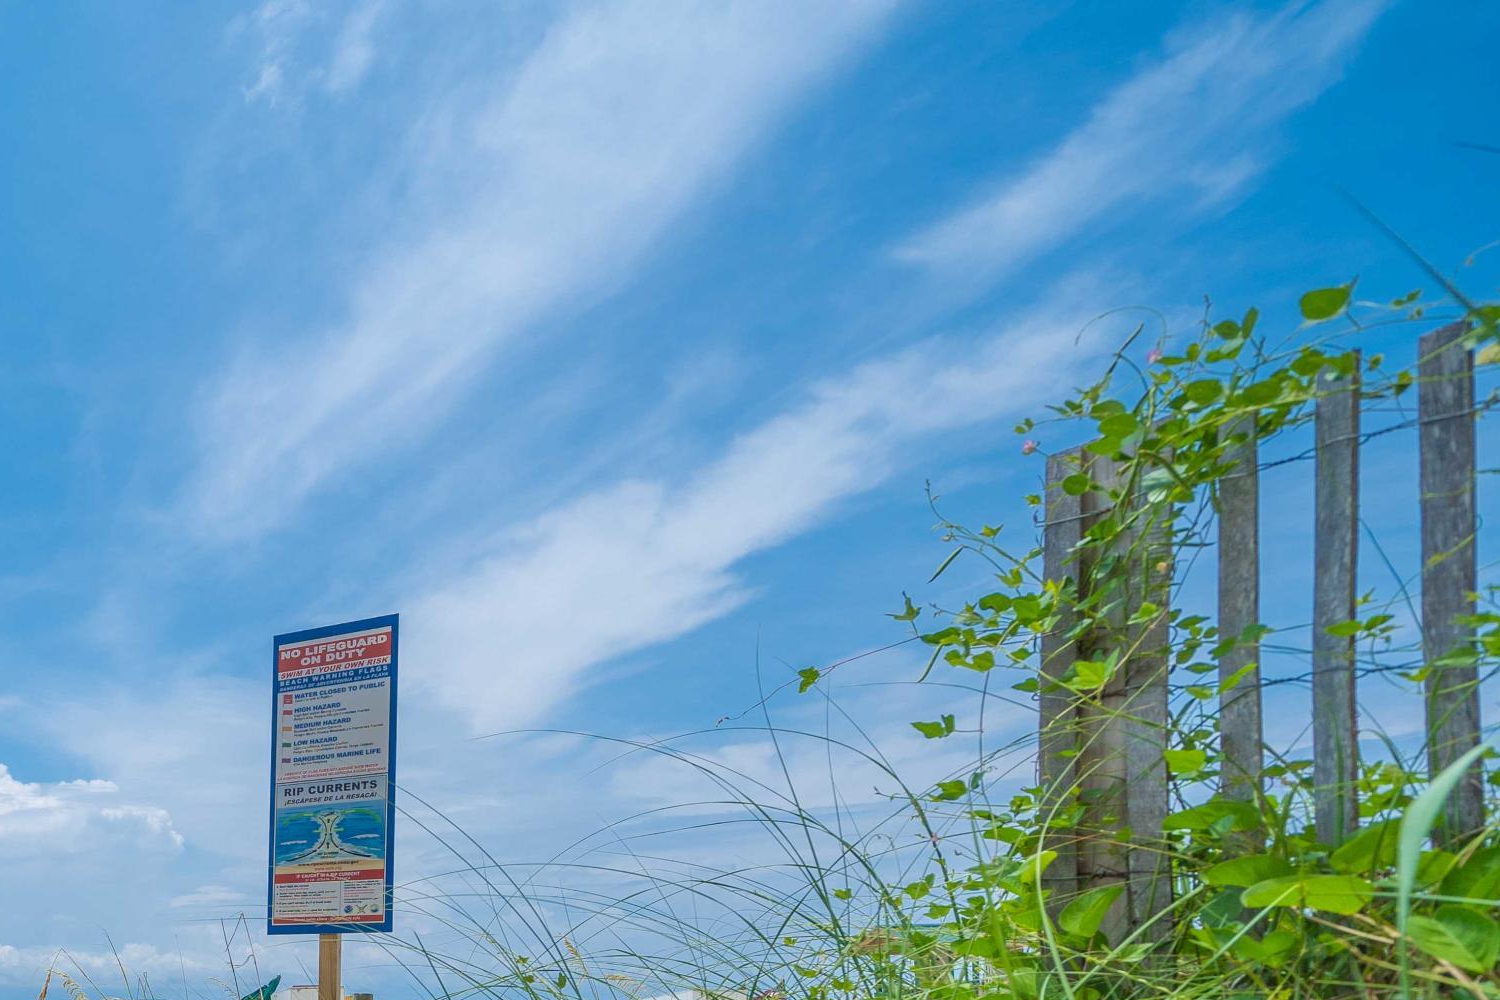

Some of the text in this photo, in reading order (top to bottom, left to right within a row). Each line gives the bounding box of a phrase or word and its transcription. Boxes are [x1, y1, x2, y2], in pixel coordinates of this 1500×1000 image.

[281, 635, 388, 660] NO LIFEGUARD
[300, 648, 366, 666] ON DUTY
[280, 656, 389, 680] SWIM AT YOUR OWN RISK
[280, 664, 388, 687] BEACH WARNING FLAGS
[294, 691, 318, 700] WATER
[319, 687, 347, 697] CLOSED
[359, 681, 385, 691] PUBLIC
[294, 705, 312, 714] HIGH
[312, 702, 341, 712] HAZARD
[294, 721, 321, 730] MEDIUM
[322, 717, 351, 726] HAZARD
[309, 736, 338, 745] HAZARD
[293, 753, 335, 763] DANGEROUS
[336, 749, 364, 759] MARINE
[284, 780, 378, 797] RIP CURRENTS
